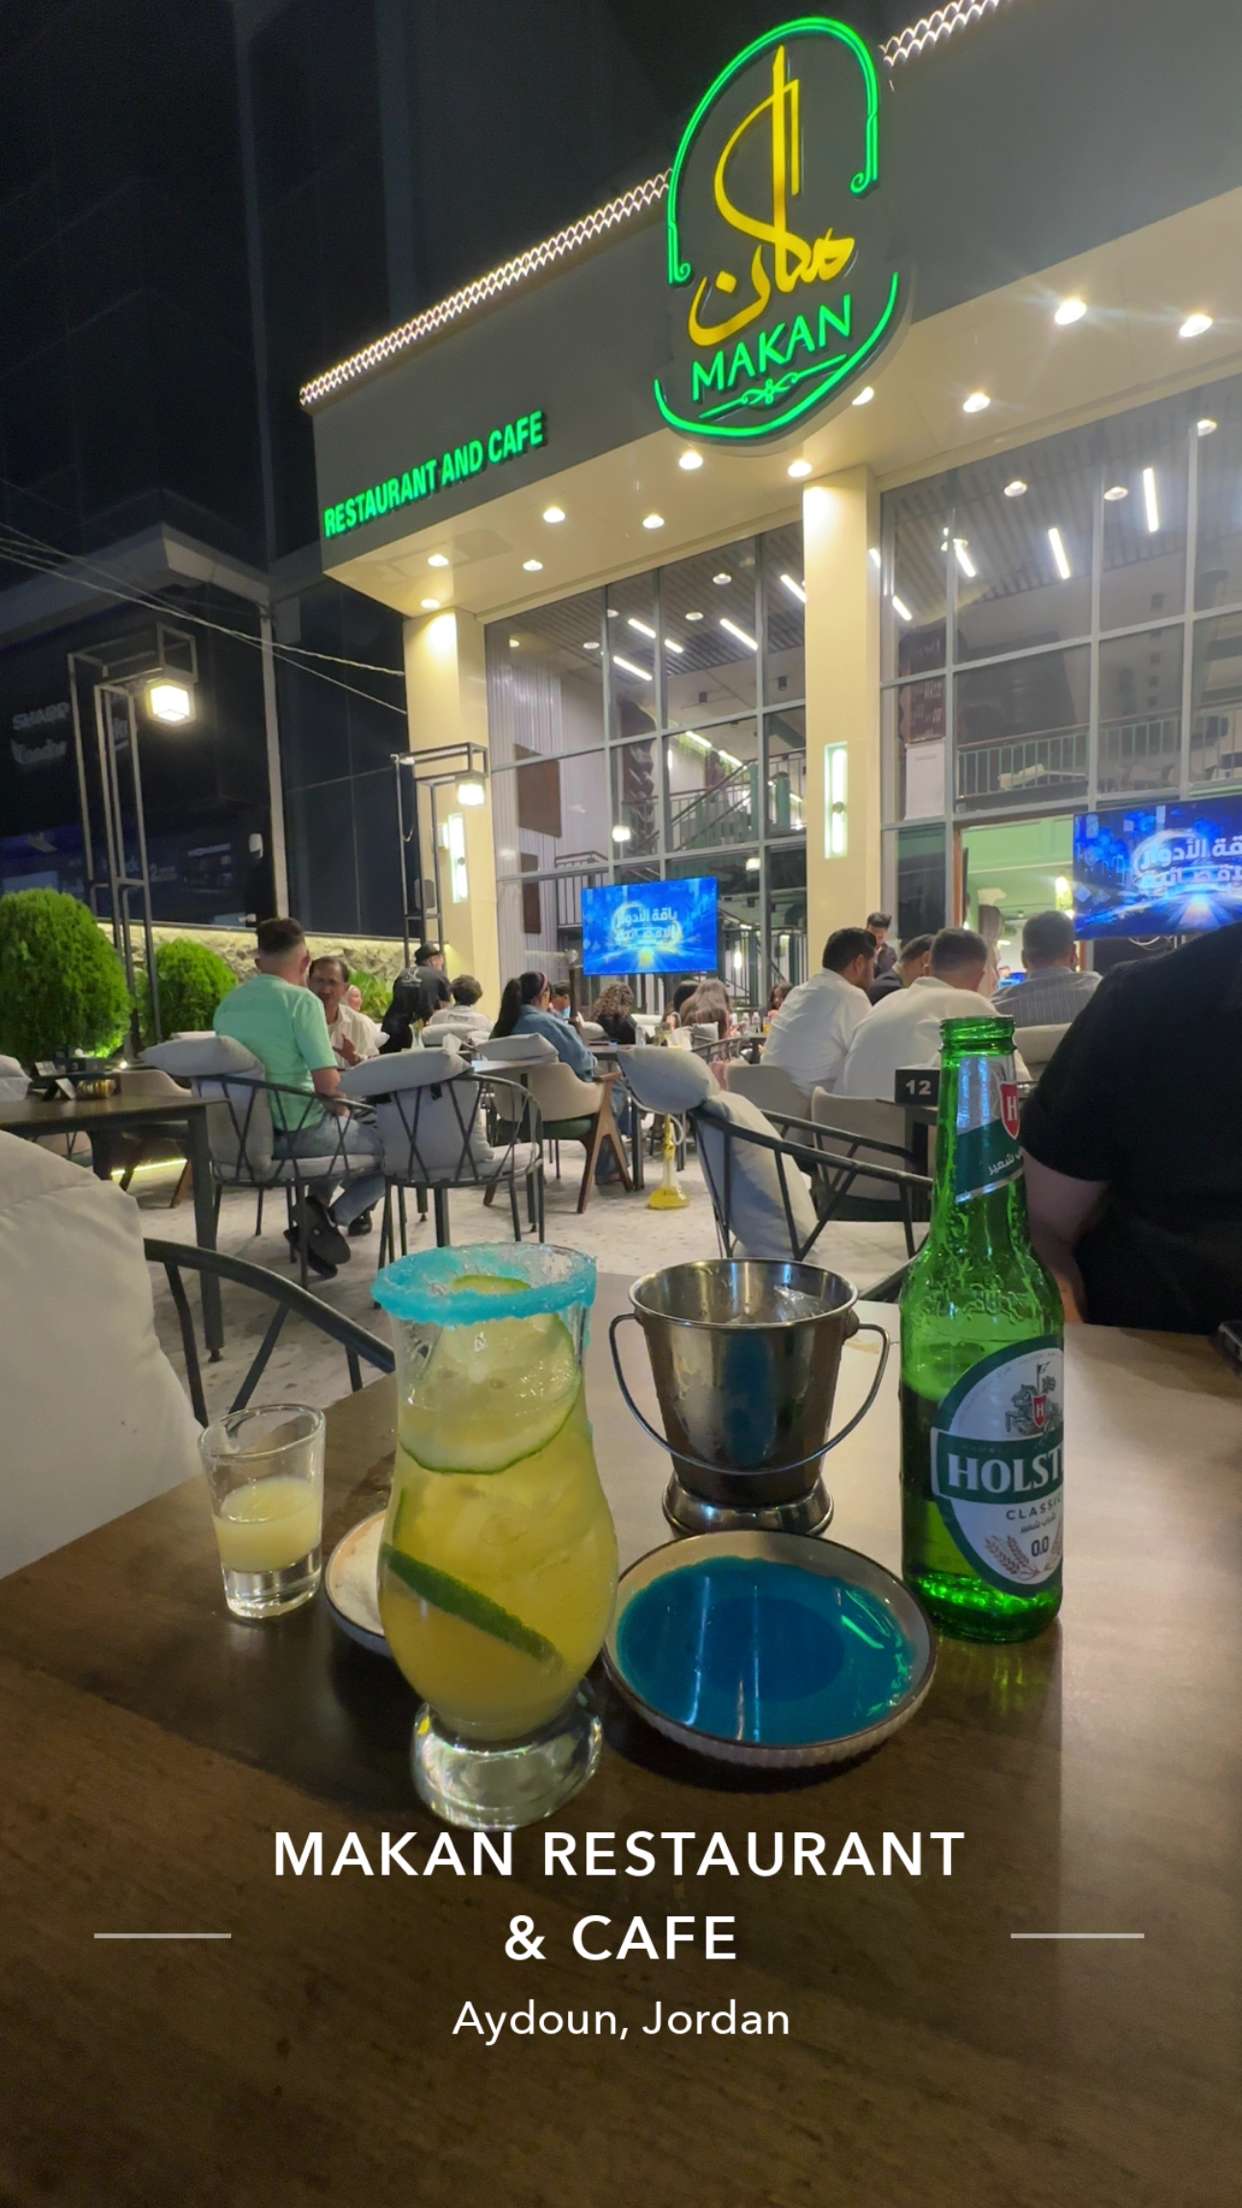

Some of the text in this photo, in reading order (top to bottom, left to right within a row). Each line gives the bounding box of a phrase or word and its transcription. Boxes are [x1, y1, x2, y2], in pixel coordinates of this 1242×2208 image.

[692, 293, 851, 401] MAKAN
[323, 410, 544, 538] RESTAURANT AND CAFE
[905, 1080, 932, 1095] 12
[1007, 1096, 1018, 1121] H
[948, 1444, 1064, 1493] HOLST
